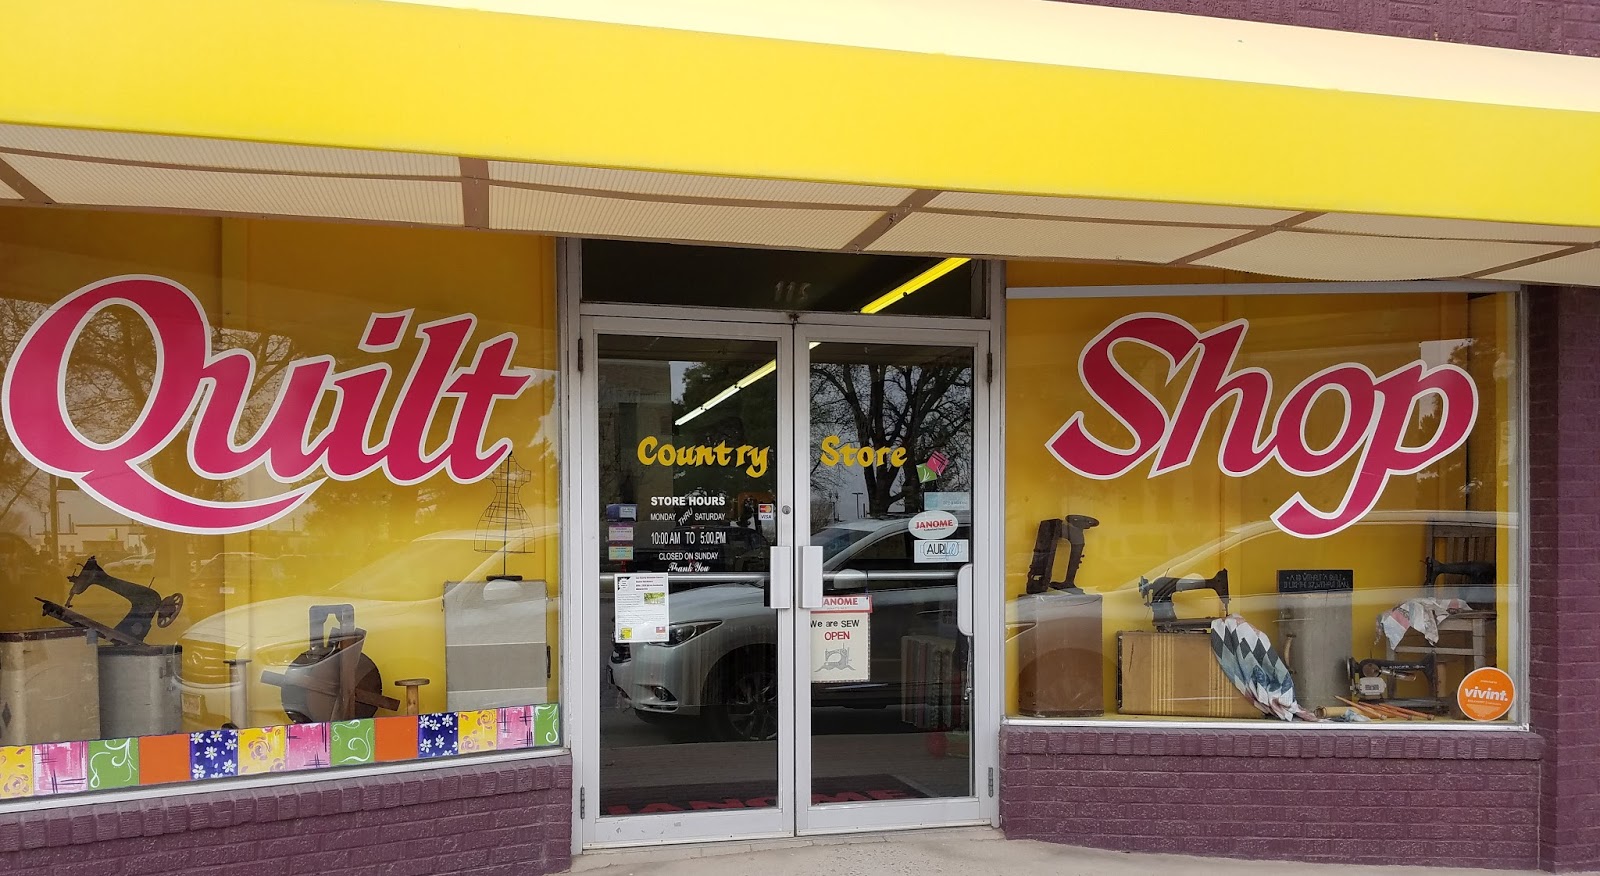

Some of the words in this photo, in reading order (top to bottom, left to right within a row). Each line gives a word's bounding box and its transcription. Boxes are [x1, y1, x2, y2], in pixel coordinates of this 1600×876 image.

[2, 273, 535, 535] Quilt
[1045, 311, 1479, 539] Shop
[637, 435, 771, 479] Country
[820, 435, 908, 468] Store
[650, 496, 686, 506] STORE
[688, 496, 726, 506] HOURS
[650, 512, 677, 521] MONDAY
[677, 507, 694, 526] THRU
[694, 512, 726, 521] SATURDAY
[915, 519, 954, 530] JANOME
[650, 531, 668, 545] 10:00
[669, 531, 681, 545] AM
[685, 531, 696, 544] TO
[658, 552, 684, 561] CLOSED
[684, 552, 694, 560] ON
[694, 551, 719, 560] SUNDAY
[667, 562, 694, 572] Thank
[694, 561, 711, 572] You
[823, 597, 859, 606] ANOME
[810, 620, 823, 628] We
[825, 620, 838, 628] are
[840, 619, 860, 628] SEW
[824, 631, 850, 641] OPEN
[1464, 685, 1509, 702] vivint.
